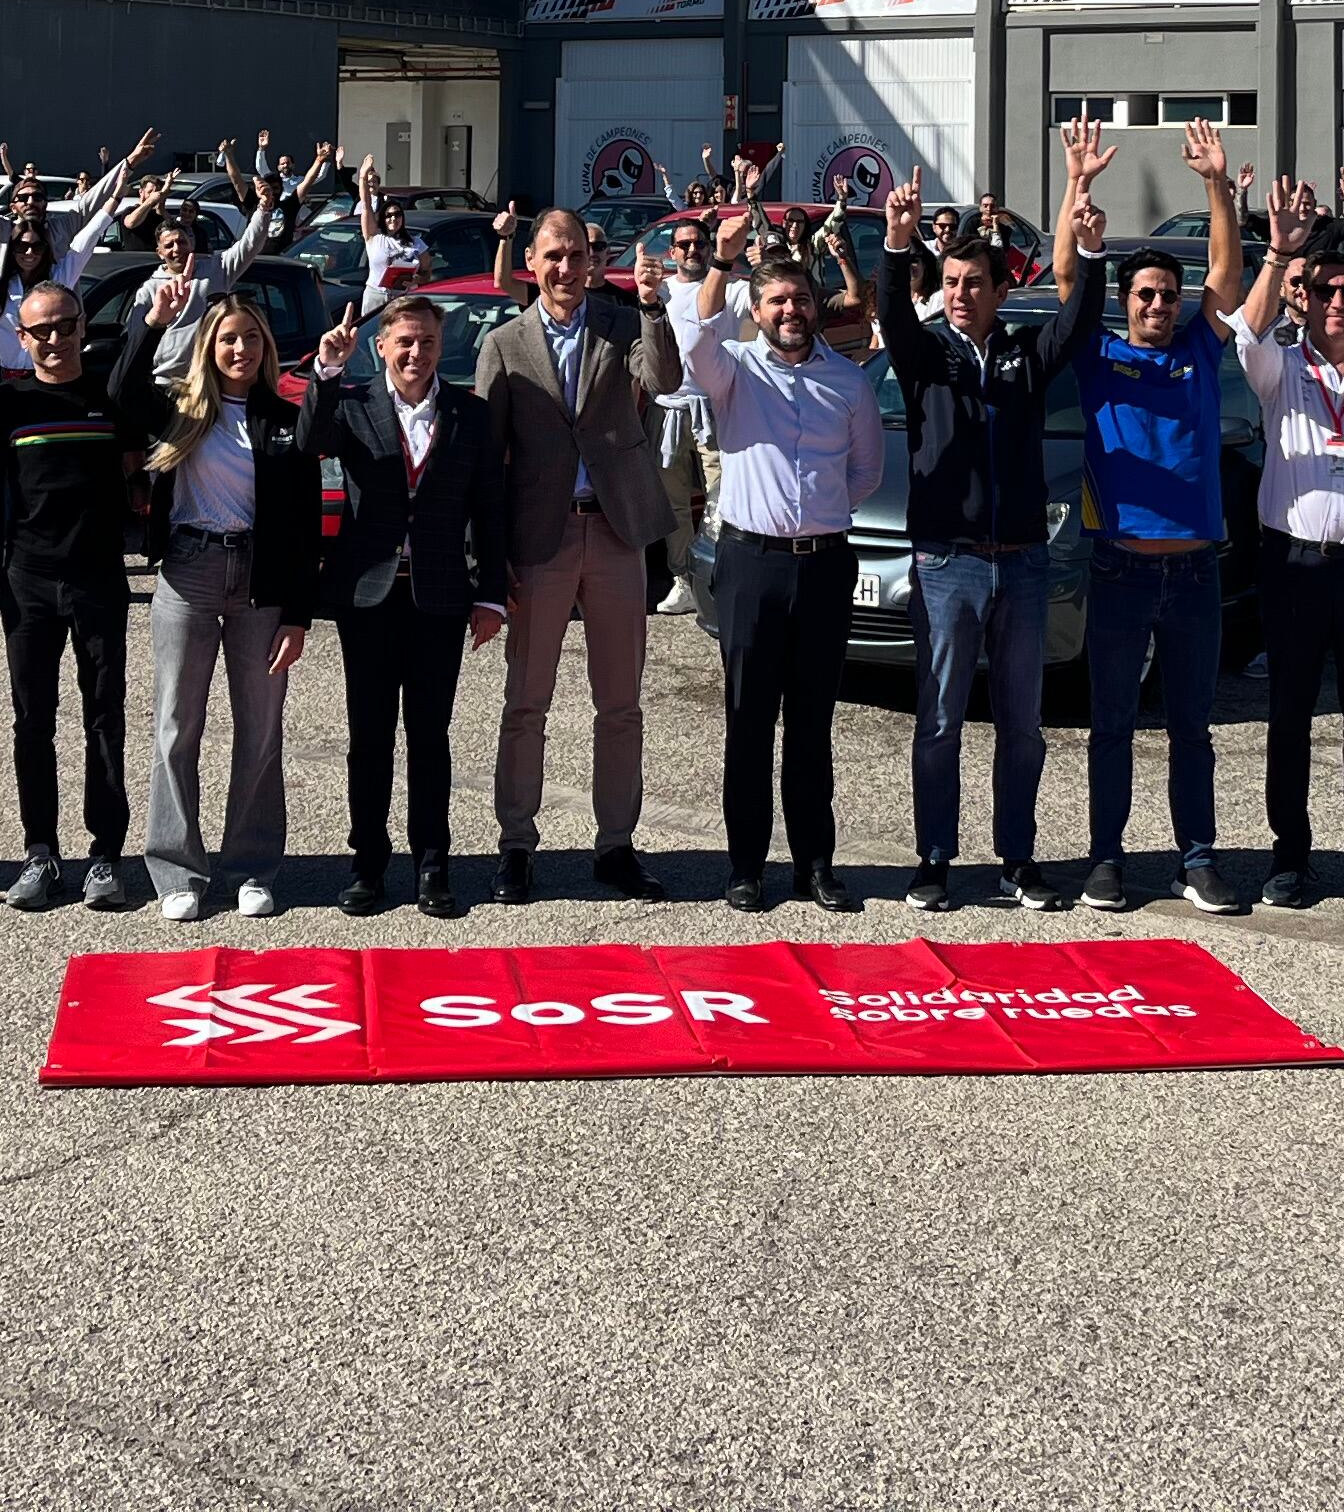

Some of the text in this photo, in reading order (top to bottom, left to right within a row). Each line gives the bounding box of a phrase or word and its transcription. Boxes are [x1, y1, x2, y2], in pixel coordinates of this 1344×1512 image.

[582, 126, 651, 194] CUNA DE CAMPEONES
[817, 153, 829, 171] DE
[826, 132, 889, 156] CAMPEONES
[419, 990, 771, 1028] SoSR
[818, 984, 1145, 1007] Solidaridad
[830, 1001, 1198, 1022] sobre ruedas
